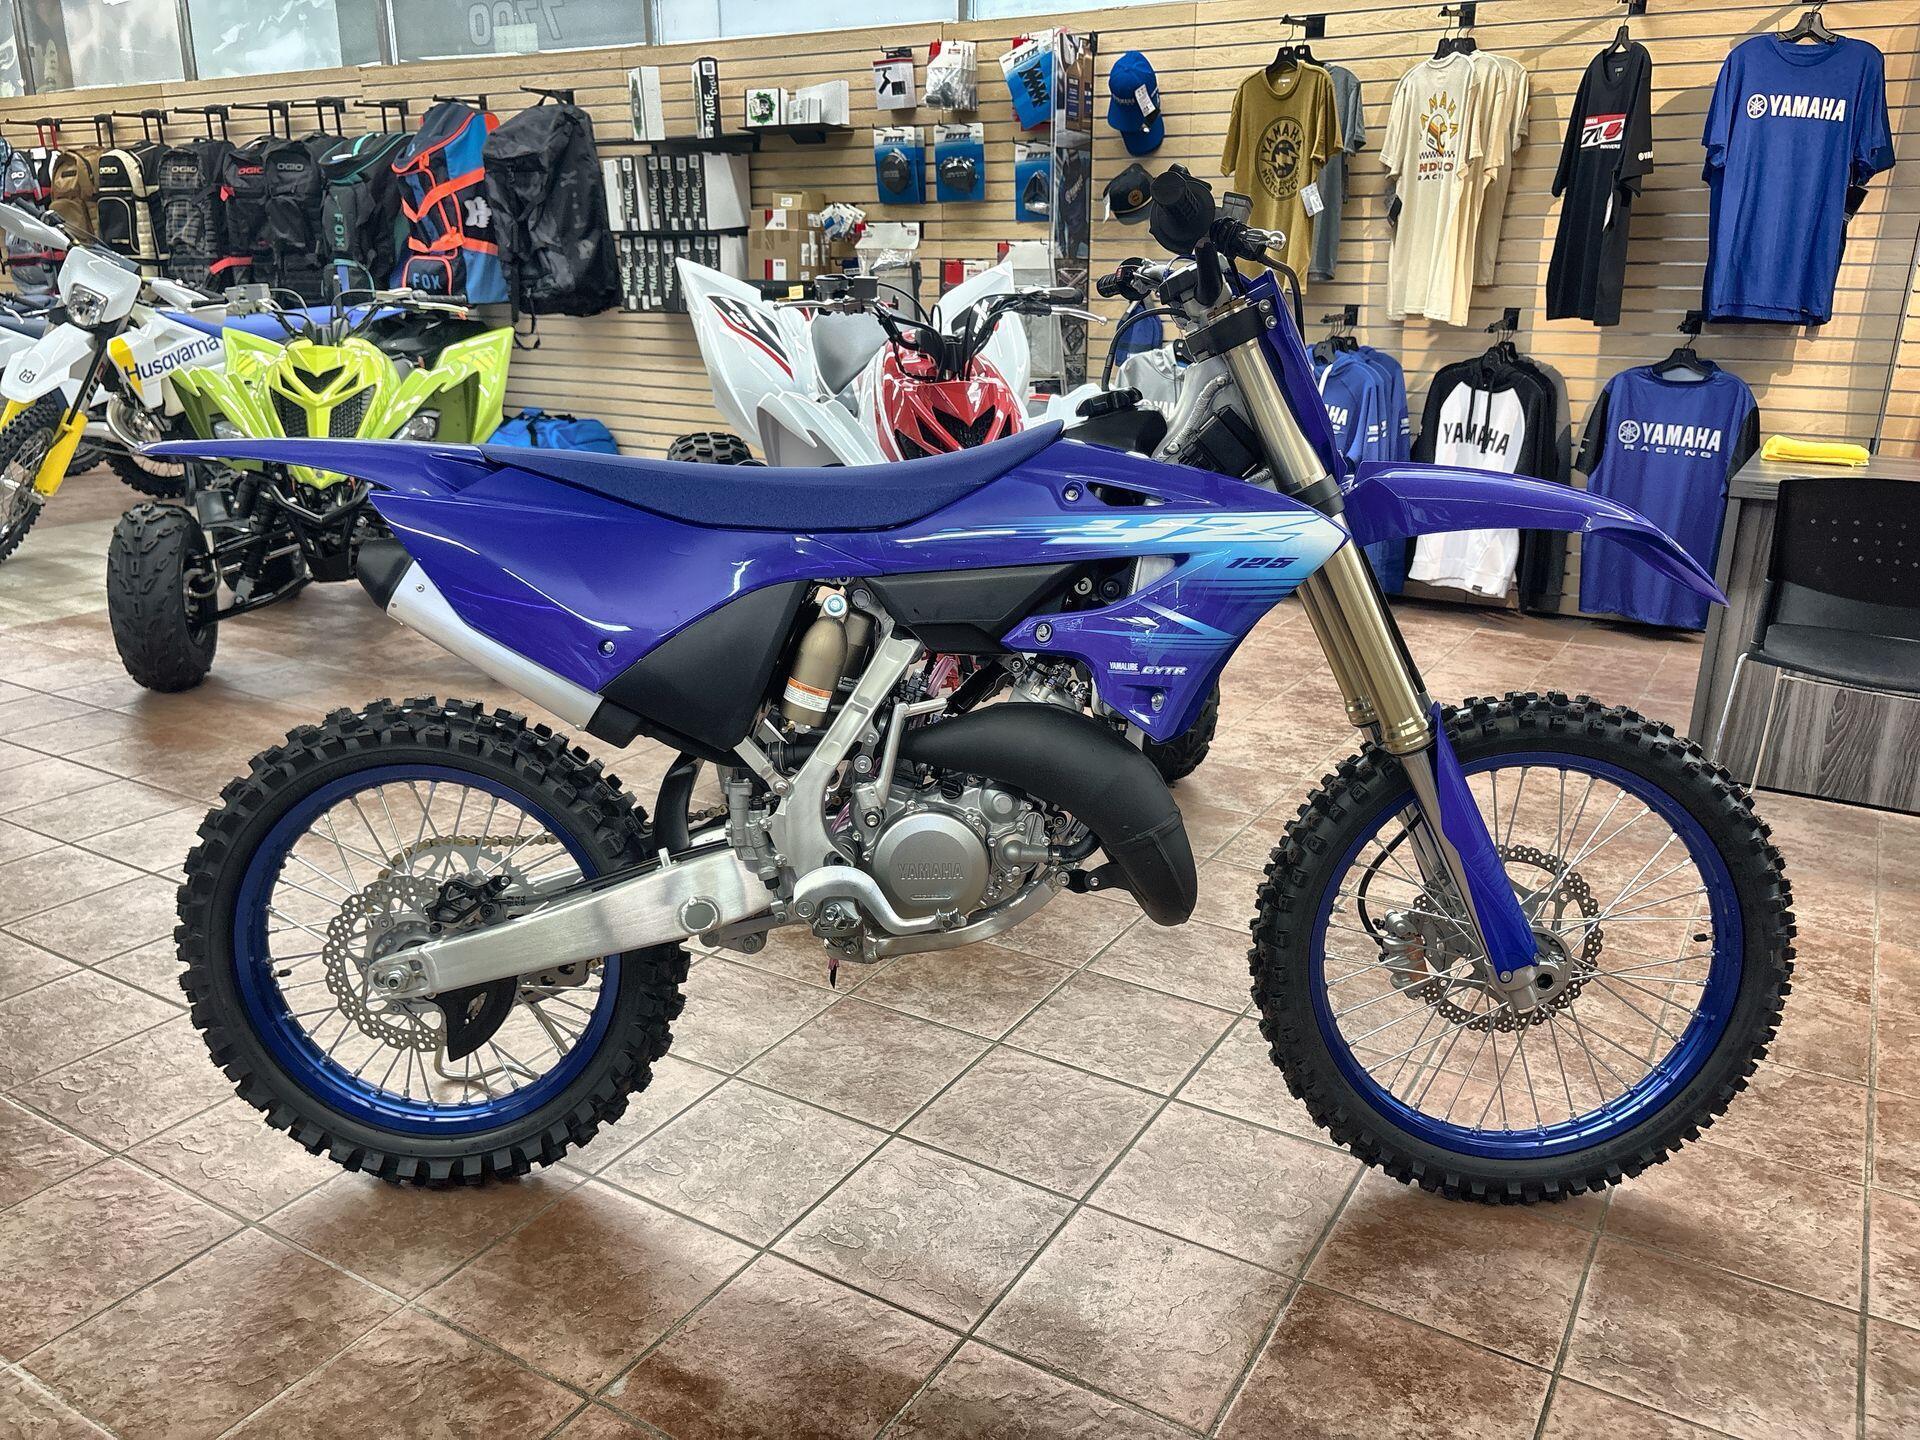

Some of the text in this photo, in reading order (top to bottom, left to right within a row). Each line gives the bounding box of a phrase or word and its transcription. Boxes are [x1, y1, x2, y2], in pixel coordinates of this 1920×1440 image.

[704, 93, 716, 121] RAGE
[1769, 94, 1847, 122] YAMAHA
[1262, 123, 1302, 154] YAMAHA
[171, 165, 197, 173] OGIO
[277, 162, 304, 171] OGIO
[624, 188, 633, 214] RAGE
[649, 187, 658, 213] RAGE
[663, 187, 673, 213] RAGE
[677, 187, 687, 213] RAGE
[691, 187, 701, 213] RAGE
[333, 212, 346, 248] FOX
[412, 272, 443, 291] FOX
[123, 334, 220, 382] Husqvarna
[1443, 422, 1510, 456] YAMAHA
[1642, 422, 1722, 452] YAMAHA
[1623, 444, 1712, 459] RACING
[1224, 557, 1300, 569] 125
[1109, 661, 1189, 676] YAMALUBE GYTR
[897, 862, 965, 880] YAMAHA
